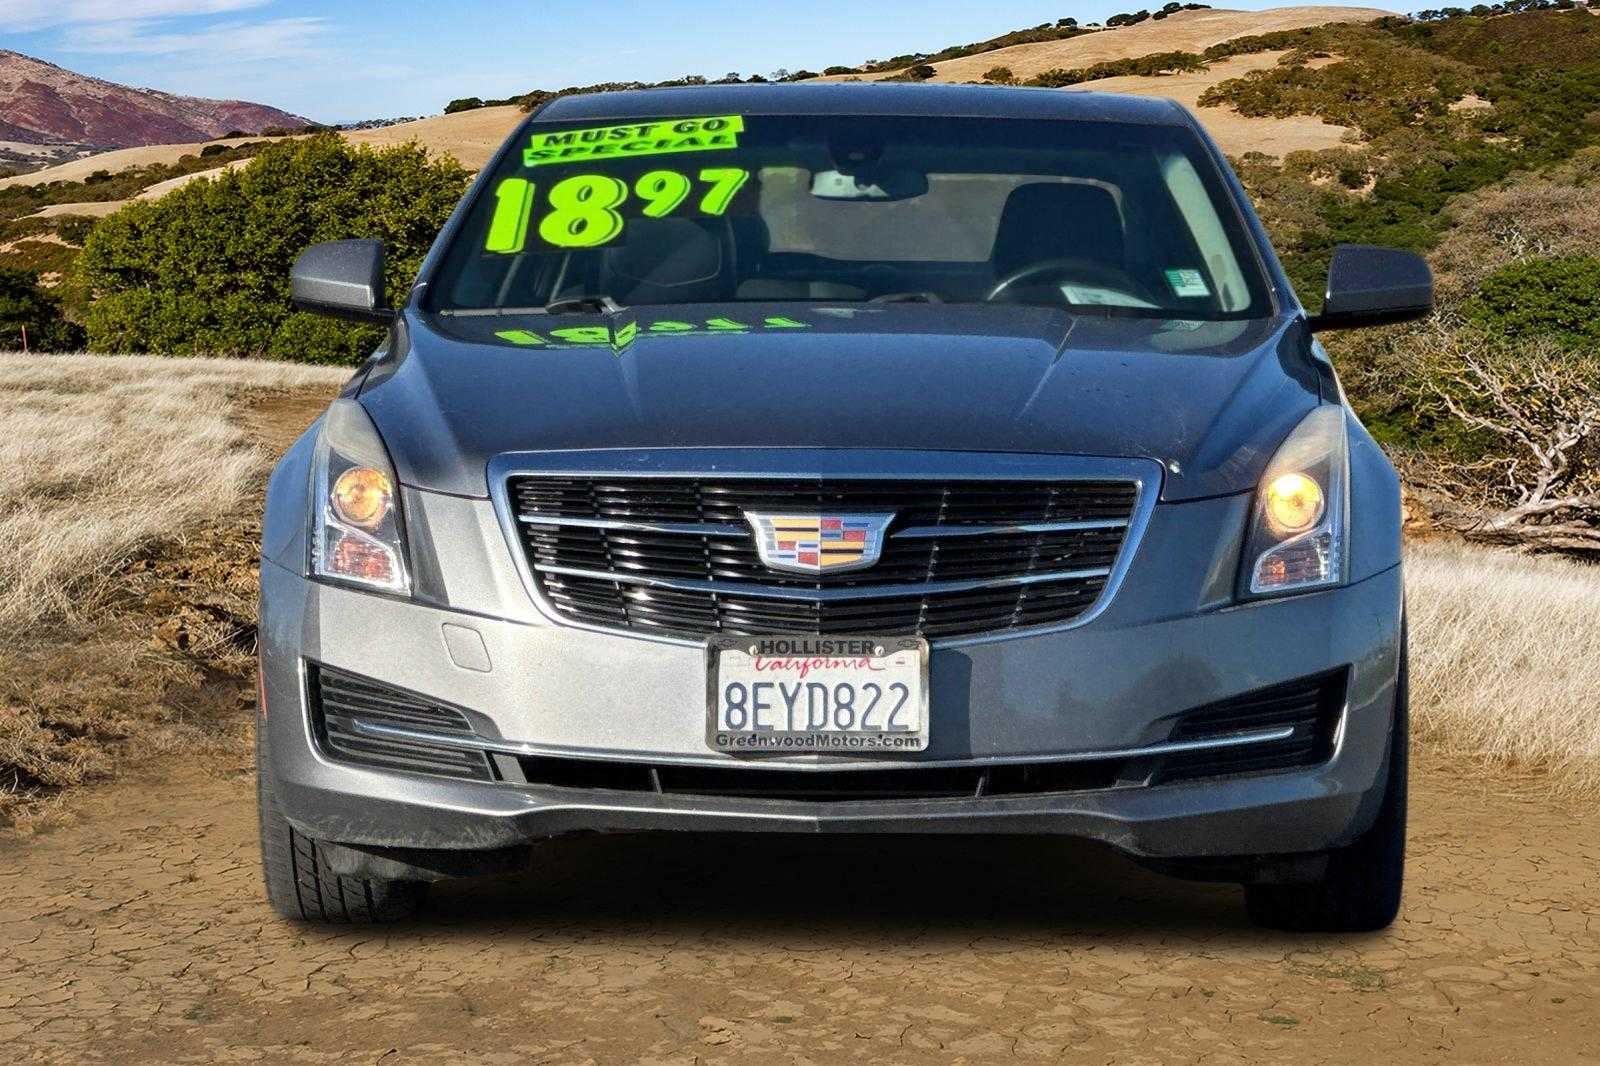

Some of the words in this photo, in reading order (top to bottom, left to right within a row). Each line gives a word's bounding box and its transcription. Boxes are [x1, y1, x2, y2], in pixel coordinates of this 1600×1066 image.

[543, 125, 660, 147] MUST
[672, 119, 729, 134] GO
[528, 135, 732, 161] SPECIAL
[758, 640, 876, 655] HOLLISTER
[754, 656, 886, 679] California
[724, 682, 910, 732] 8EYD822
[715, 733, 922, 748] GreenwoodMotors.com
